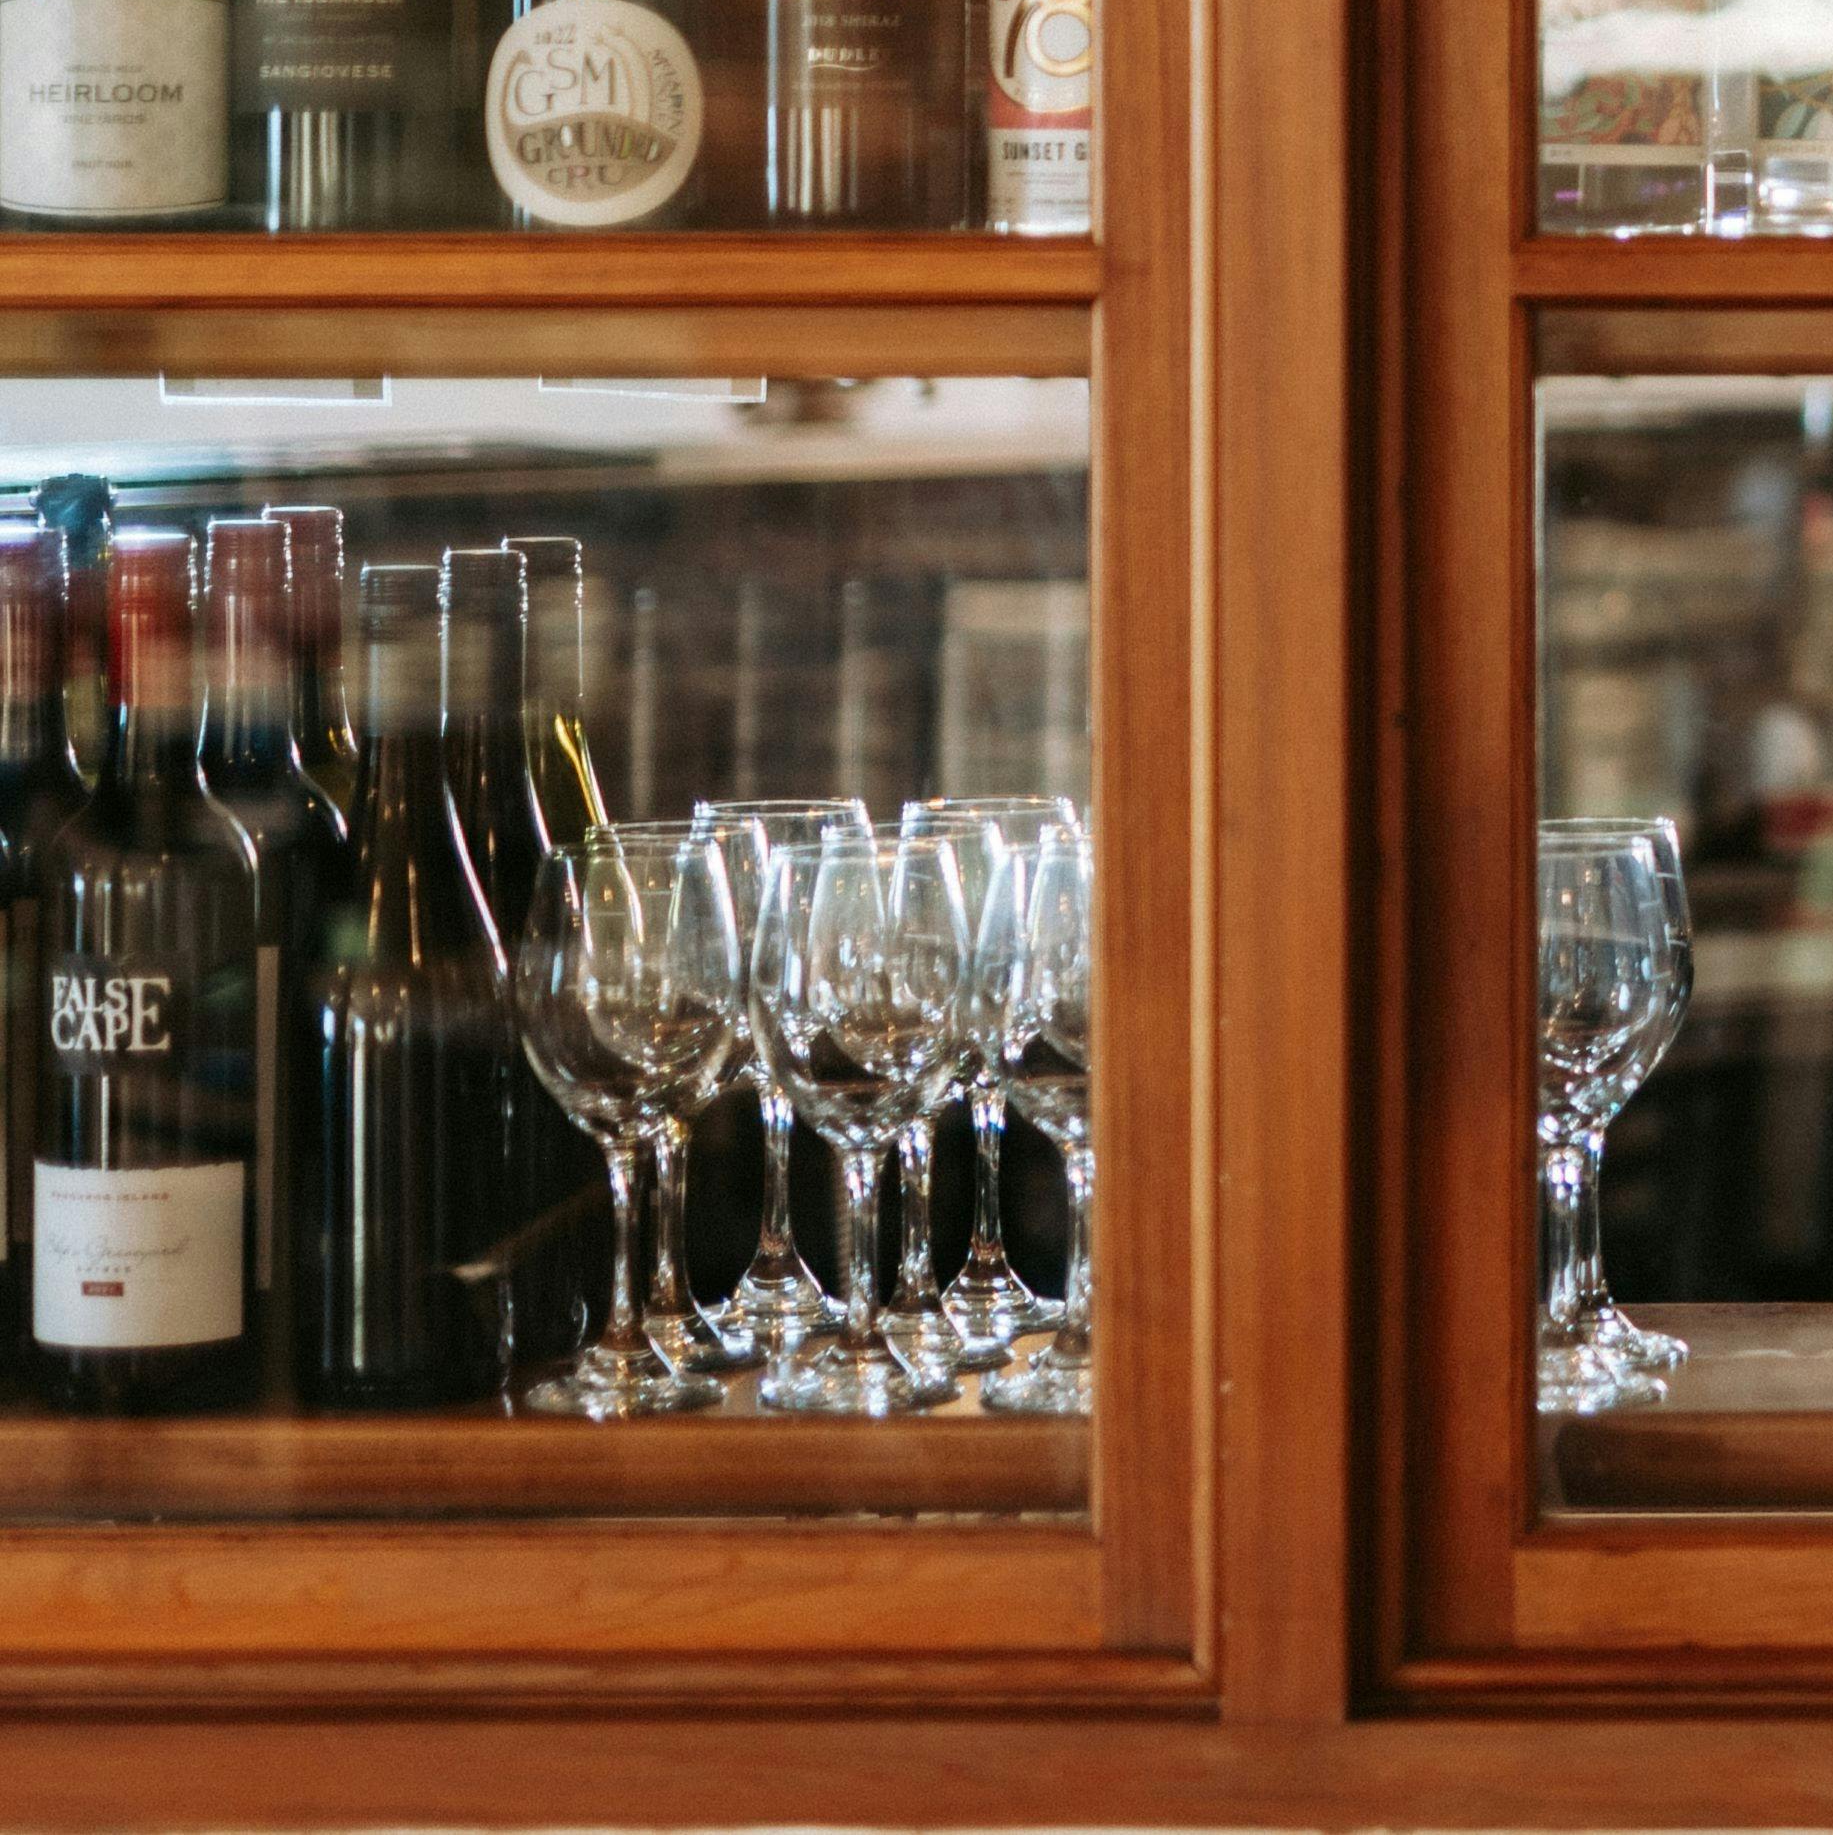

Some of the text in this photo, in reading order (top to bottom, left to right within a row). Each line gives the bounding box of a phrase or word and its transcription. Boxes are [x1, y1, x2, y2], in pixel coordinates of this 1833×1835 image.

[807, 47, 884, 62] DUDLE
[259, 65, 394, 79] SANGIOVESE
[515, 47, 617, 116] GSM
[29, 83, 185, 104] HEIRLOOM
[1002, 141, 1065, 161] SUNSET
